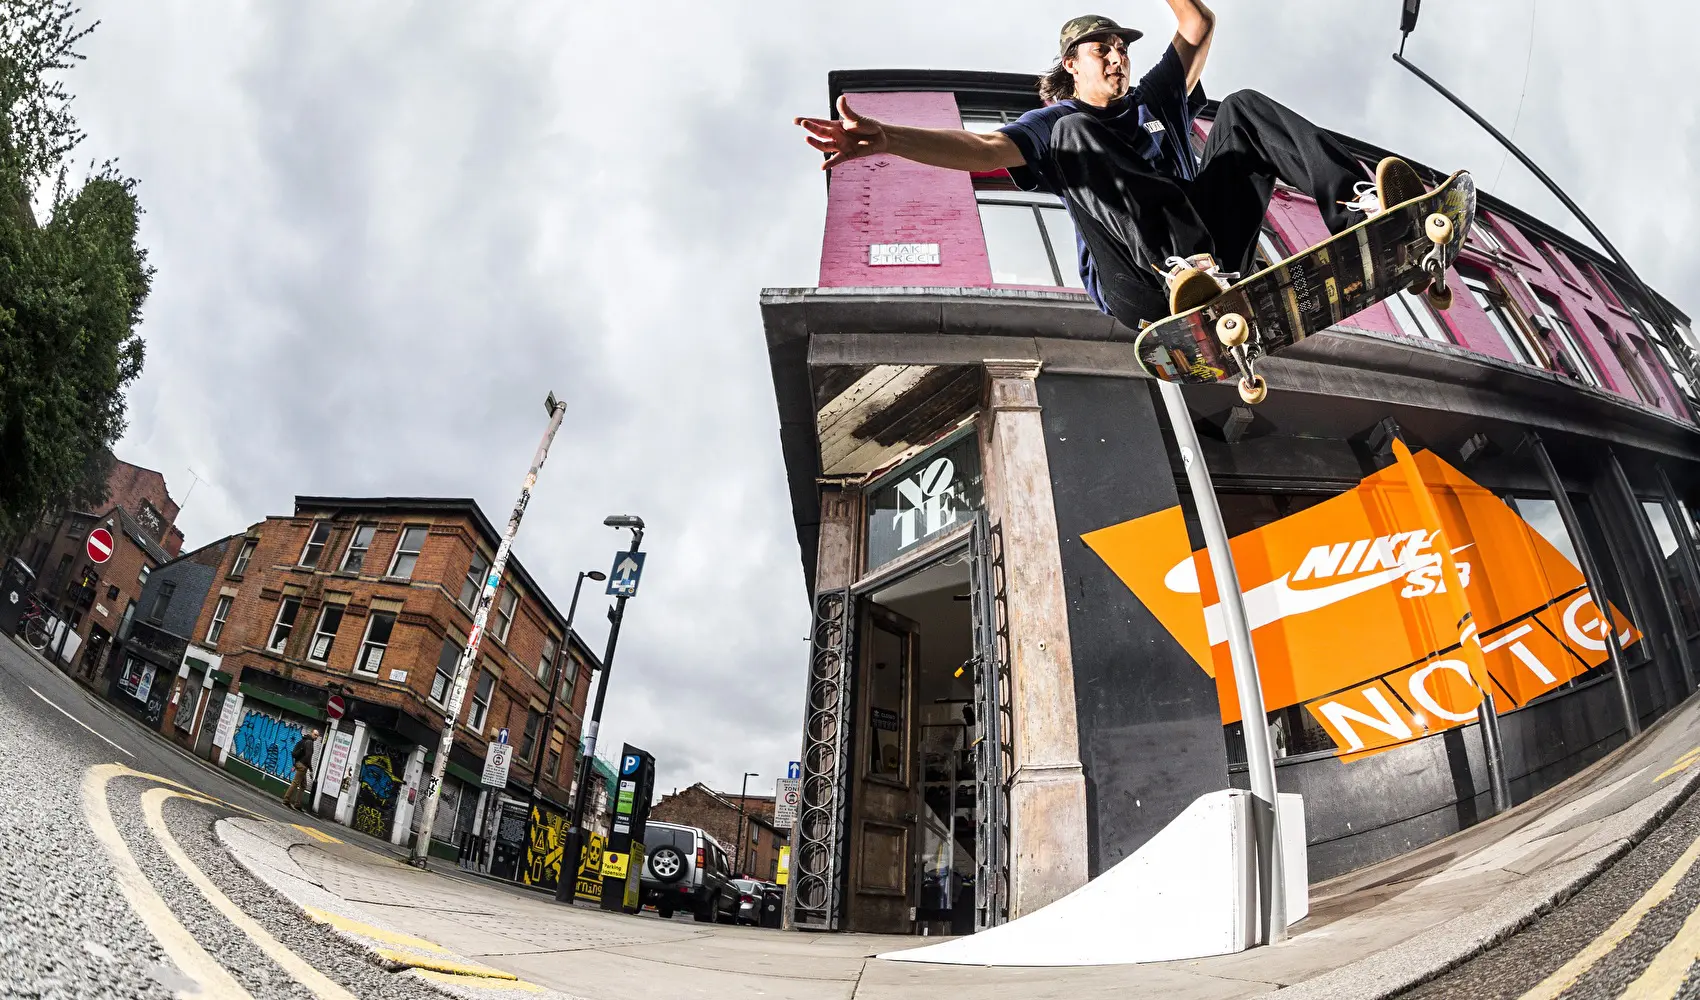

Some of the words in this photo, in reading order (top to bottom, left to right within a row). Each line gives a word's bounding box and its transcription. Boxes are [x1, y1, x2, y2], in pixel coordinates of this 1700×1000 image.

[888, 245, 920, 254] OAK
[872, 254, 937, 262] STREET
[1292, 529, 1438, 581] NIKE
[604, 863, 622, 871] Parking
[576, 880, 602, 895] rning
